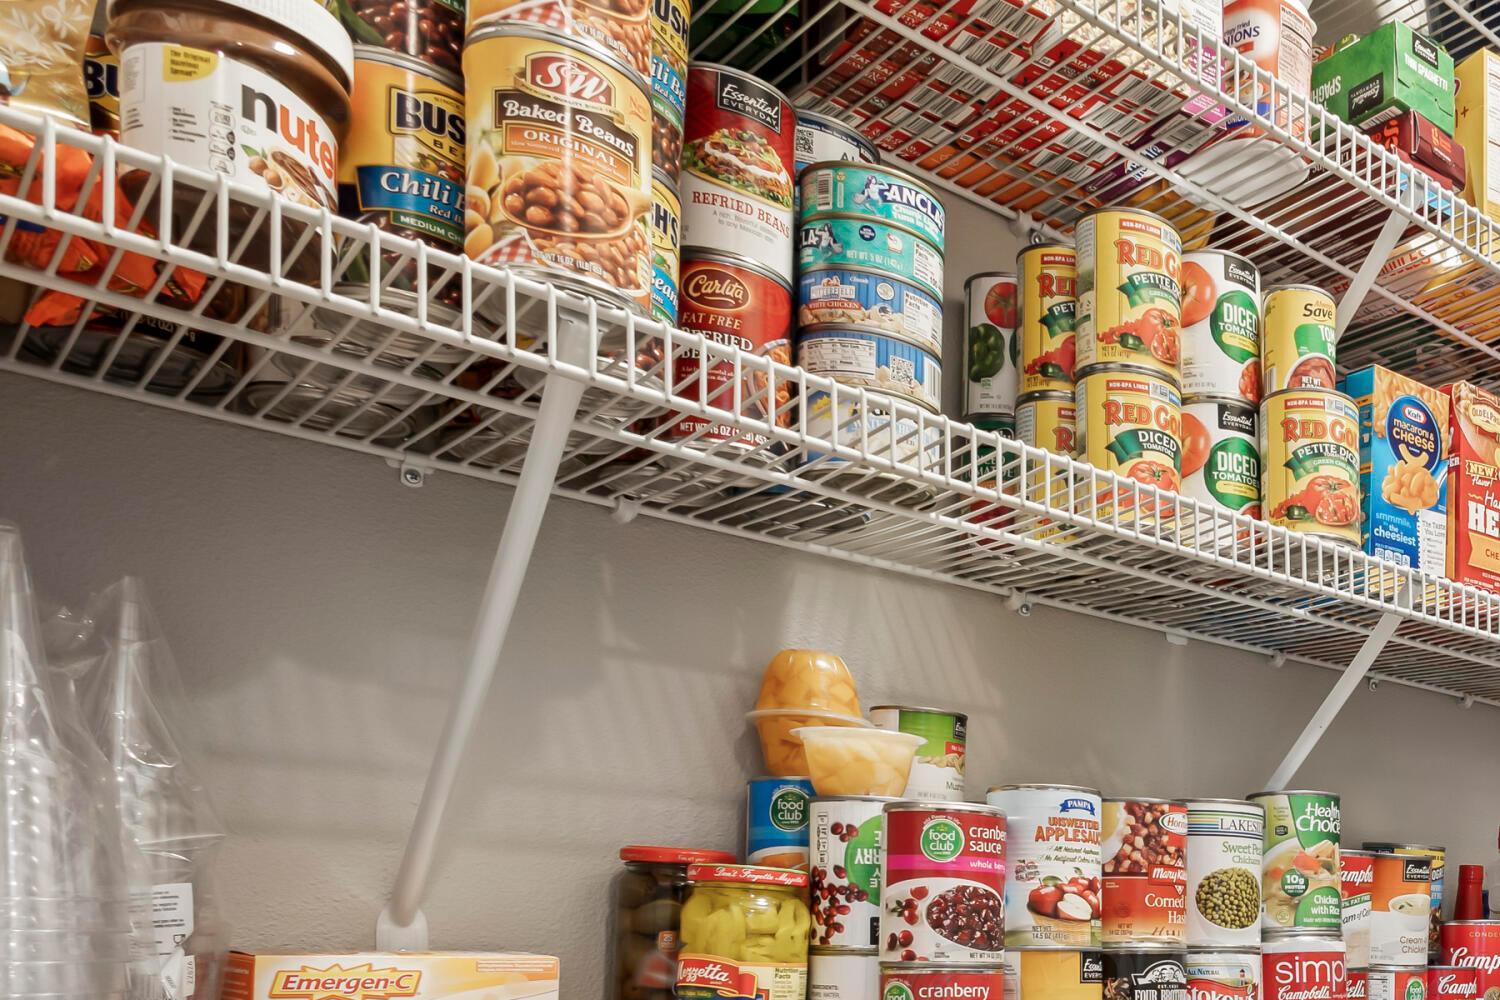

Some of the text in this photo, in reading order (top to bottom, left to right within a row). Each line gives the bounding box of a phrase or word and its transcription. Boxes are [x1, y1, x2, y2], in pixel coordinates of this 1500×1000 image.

[722, 82, 778, 118] Essential
[395, 89, 465, 145] BUS
[723, 99, 778, 128] EVERYDAY
[503, 100, 634, 158] Baked Beans
[523, 129, 617, 168] ORIGINAL
[380, 172, 451, 204] Chili
[692, 191, 754, 217] REFRIED
[757, 210, 790, 238] BEANS
[399, 216, 445, 236] MEDIUM
[1115, 239, 1163, 266] RED
[688, 274, 744, 300] Carlita
[1132, 273, 1170, 288] PETITE
[827, 301, 861, 310] CHICKEN
[1302, 302, 1333, 319] Save
[682, 311, 741, 330] FAT FREE
[1222, 302, 1257, 330] DICED
[1104, 400, 1151, 427] RED
[1282, 417, 1327, 443] RED
[1393, 417, 1428, 439] macaroni
[1138, 430, 1177, 451] DICED
[1297, 446, 1338, 459] PETITE
[1216, 452, 1257, 477] DICED
[1469, 463, 1495, 480] NEW
[1373, 527, 1416, 548] cheesiest
[1387, 523, 1402, 535] the
[777, 799, 803, 810] food
[777, 809, 803, 820] club
[1067, 801, 1092, 810] PAMPA
[929, 829, 955, 841] food
[1296, 816, 1341, 834] Choice
[929, 840, 954, 852] club
[969, 839, 1002, 852] sauce
[1222, 842, 1250, 854] Sweet
[1145, 894, 1185, 908] Corned
[1314, 894, 1339, 907] Chicken
[282, 974, 413, 994] Emergen-C
